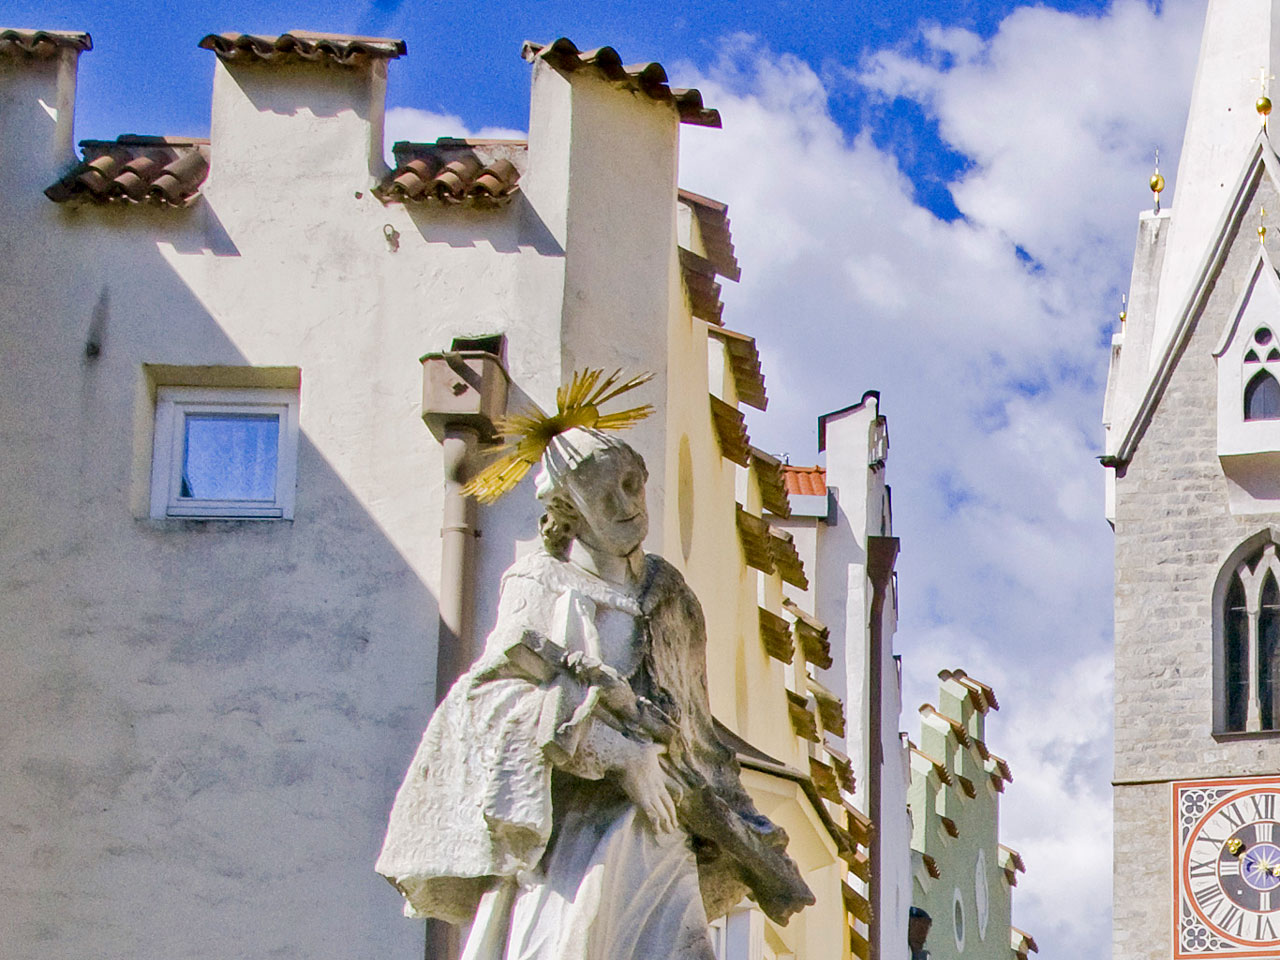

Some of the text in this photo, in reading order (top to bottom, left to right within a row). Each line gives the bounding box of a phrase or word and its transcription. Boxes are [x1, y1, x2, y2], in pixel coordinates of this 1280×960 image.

[1219, 802, 1246, 832] XI
[1249, 794, 1276, 821] XII
[1197, 828, 1225, 851] X
[1190, 858, 1216, 879] IX
